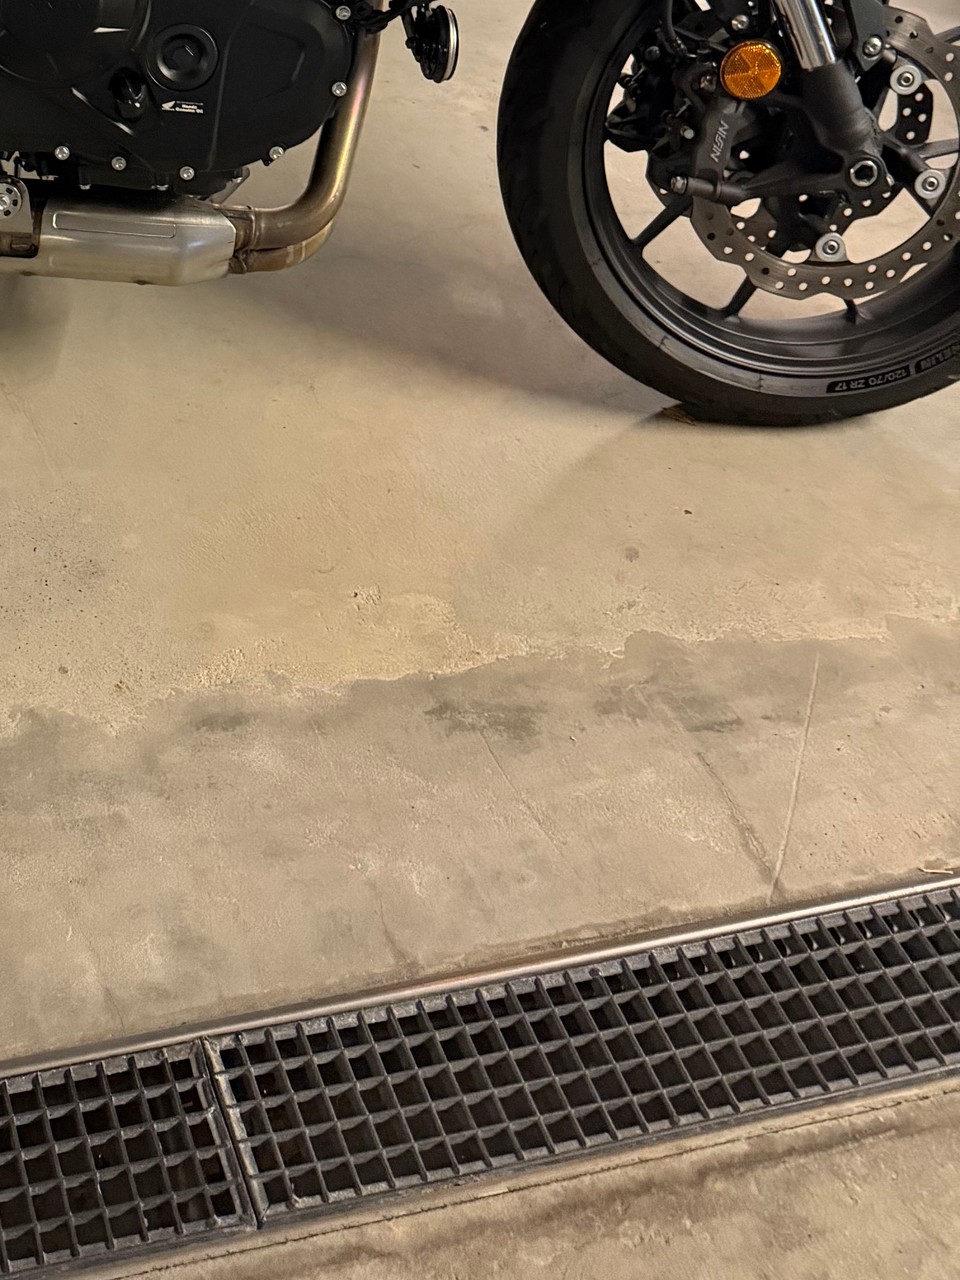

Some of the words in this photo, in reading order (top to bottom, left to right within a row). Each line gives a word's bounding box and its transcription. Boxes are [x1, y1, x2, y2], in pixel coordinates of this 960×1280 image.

[868, 368, 908, 386] 120/70
[834, 381, 848, 391] 17
[850, 378, 866, 389] ZR
